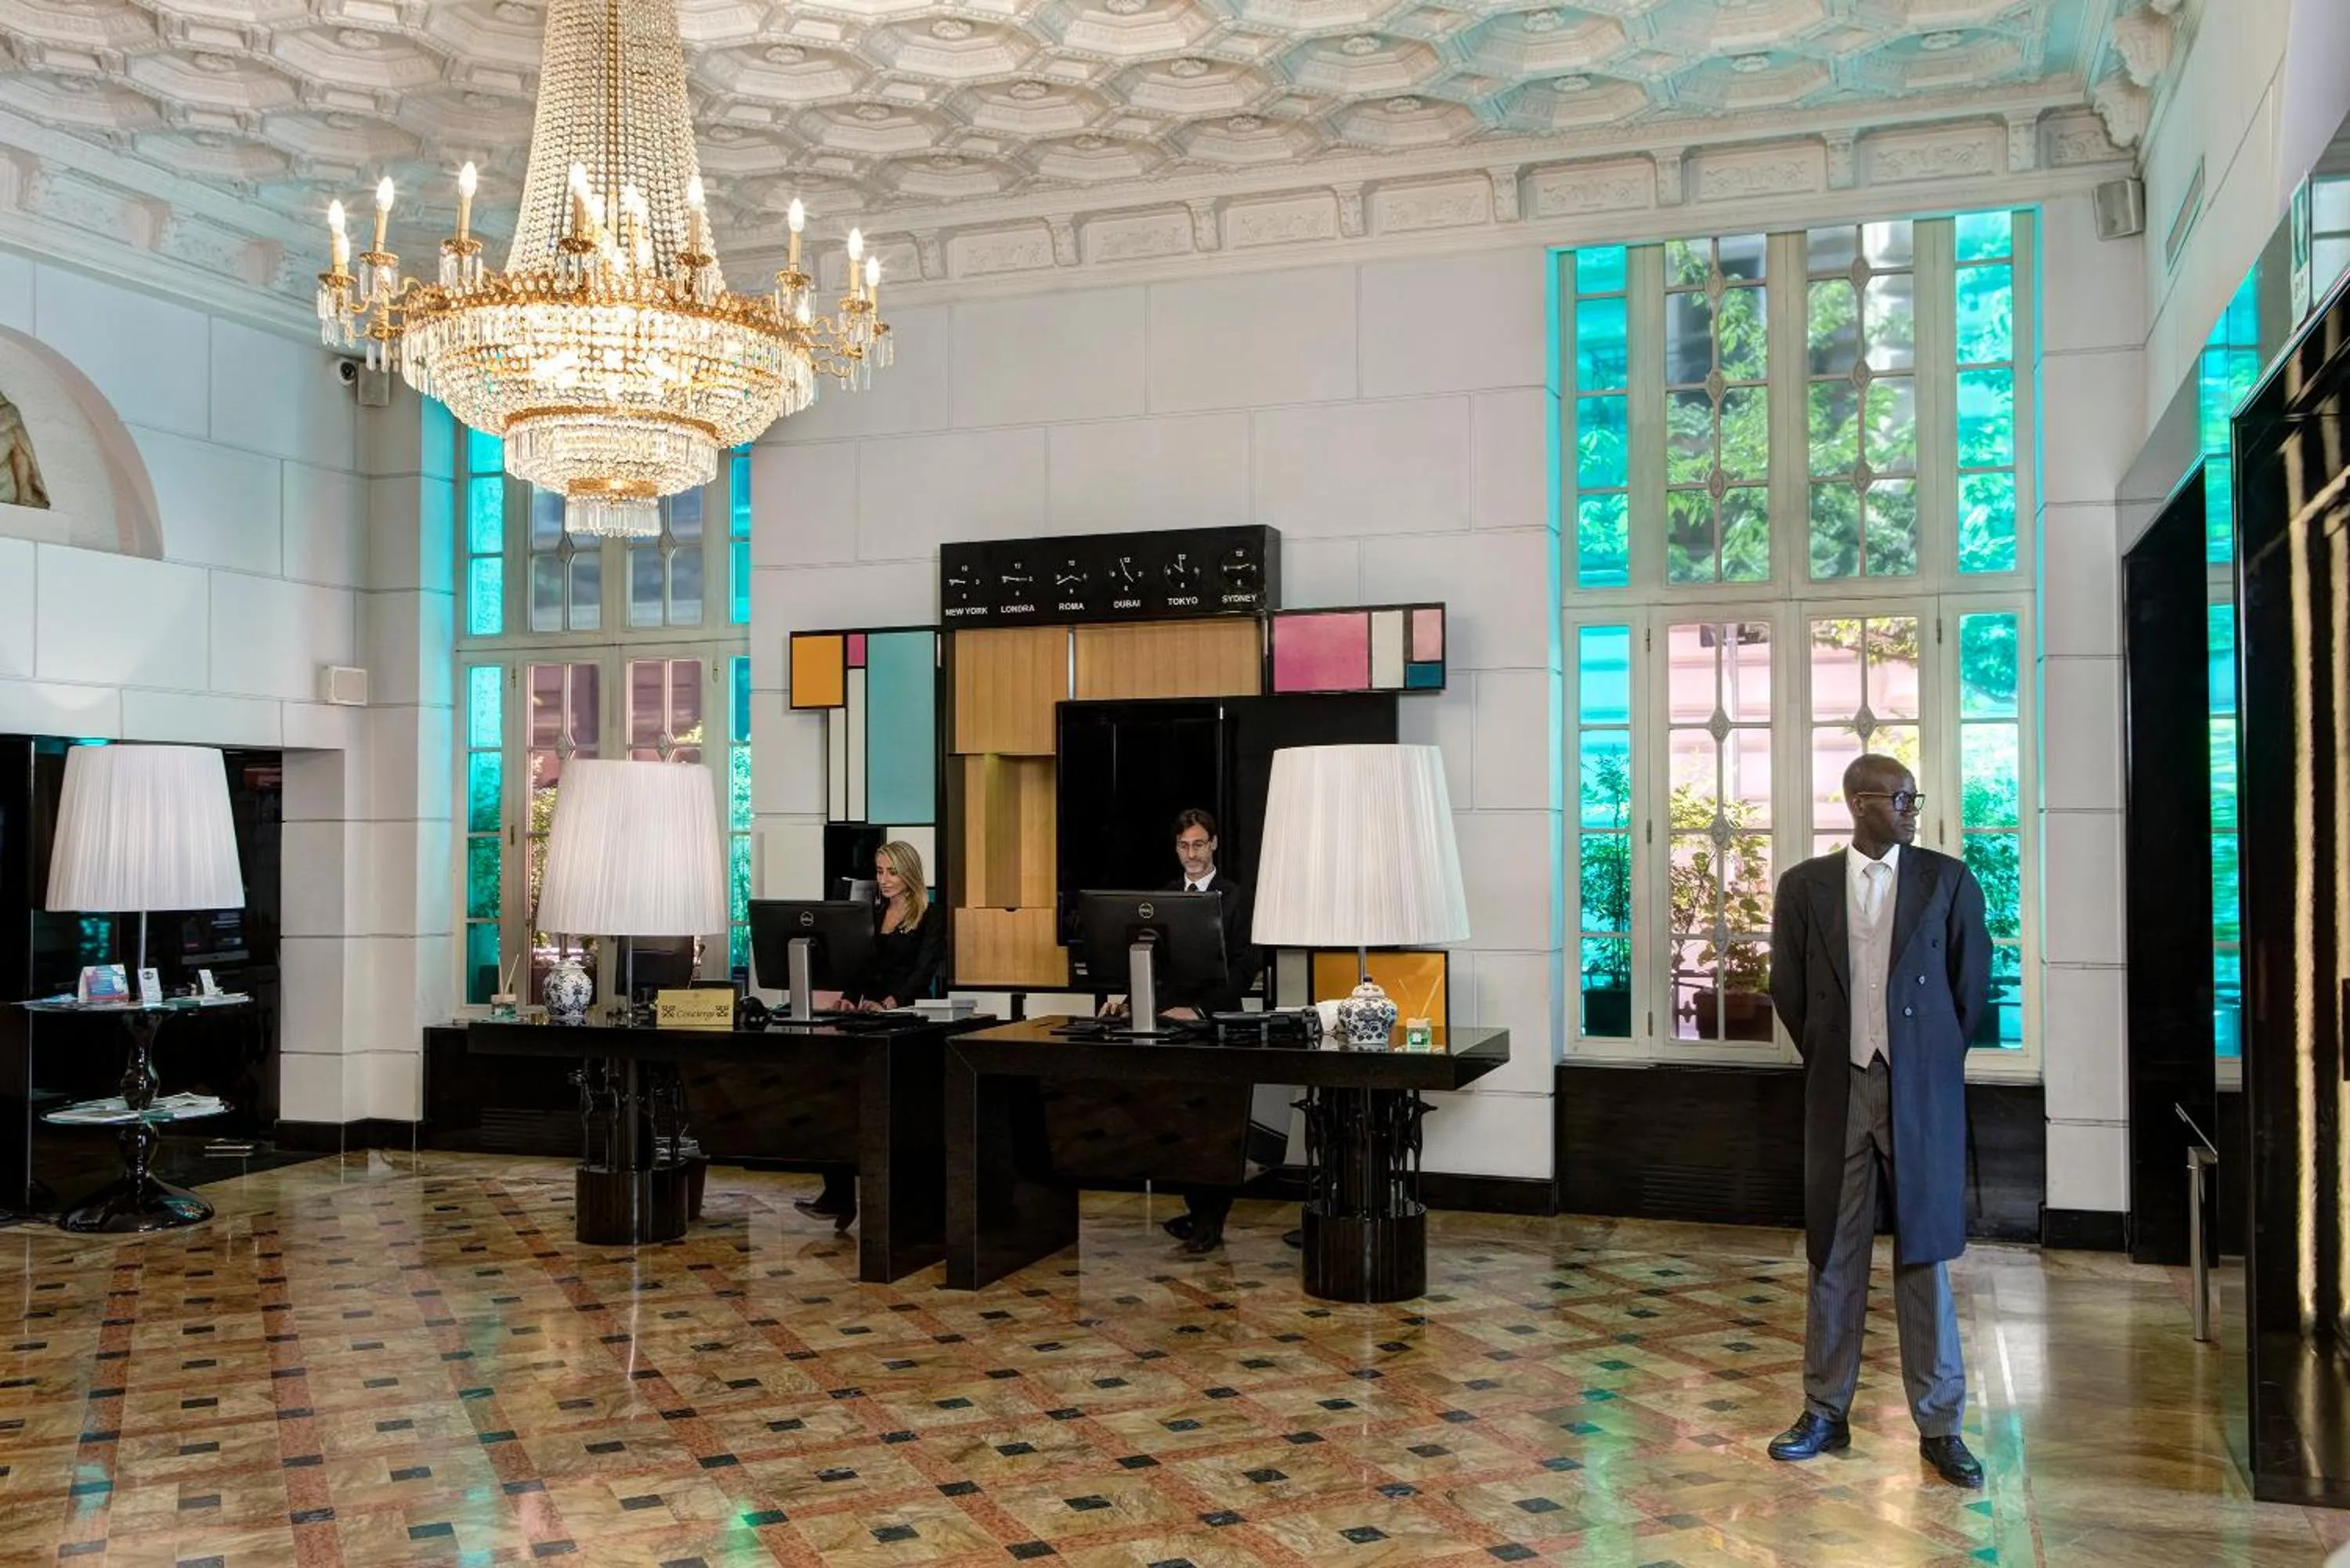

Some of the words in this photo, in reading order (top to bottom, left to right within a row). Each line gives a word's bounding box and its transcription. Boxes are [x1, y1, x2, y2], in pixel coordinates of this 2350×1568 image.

[1167, 596, 1198, 605] TOKYO
[1221, 593, 1257, 603] SYDNEY
[1000, 604, 1035, 613] LONDRA
[1113, 599, 1141, 609] DUBAI
[945, 607, 964, 616] NEW
[965, 606, 988, 615] YORK
